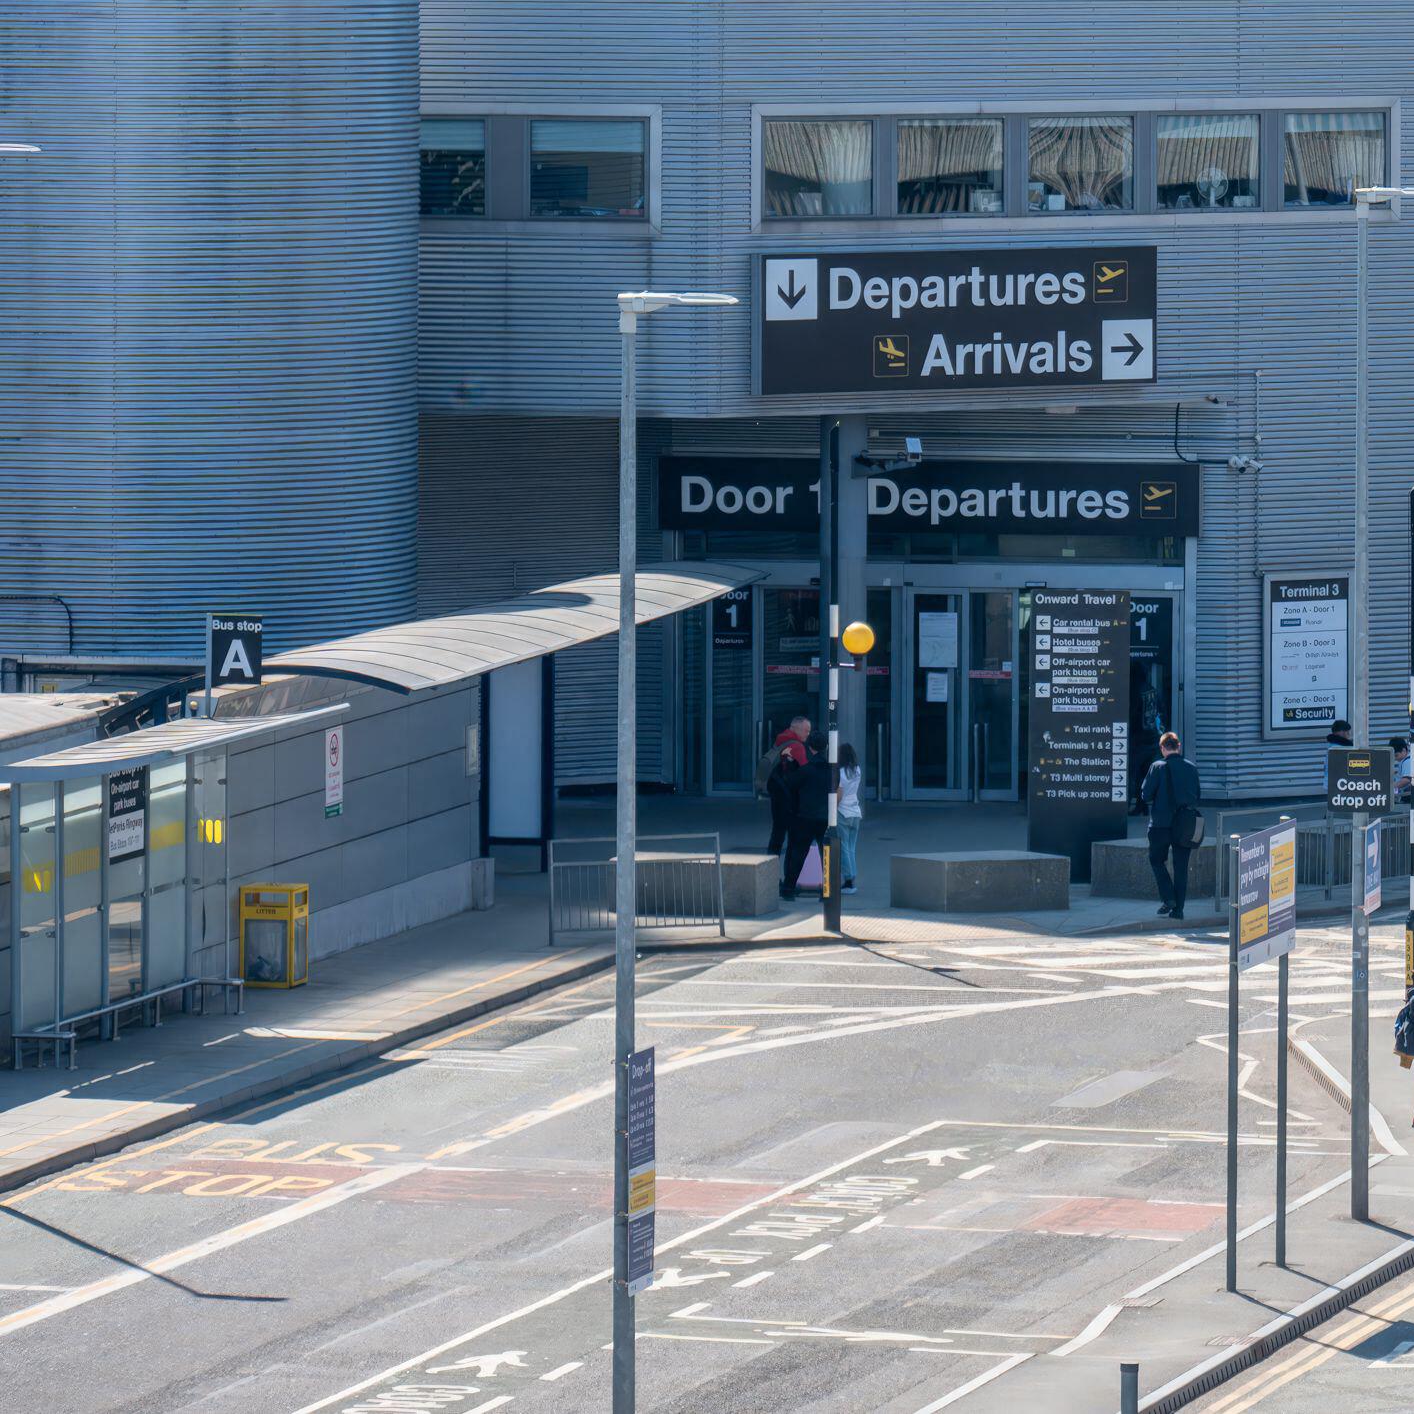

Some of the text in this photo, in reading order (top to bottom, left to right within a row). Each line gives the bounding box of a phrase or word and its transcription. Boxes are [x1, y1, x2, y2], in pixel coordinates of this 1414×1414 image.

[828, 266, 1086, 318] Departures
[920, 330, 1093, 377] Arrivals
[680, 475, 793, 514] Door
[867, 478, 1130, 525] Departures
[1280, 584, 1340, 598] Terminal 3
[1035, 594, 1116, 605] Onward Travel
[725, 604, 737, 628] 1
[1301, 606, 1308, 614] A
[212, 620, 262, 633] Bus stop
[1053, 618, 1111, 626] Car rental bus
[1135, 617, 1147, 641] 1
[219, 639, 254, 678] A
[1052, 658, 1096, 667] Off-airport
[1052, 686, 1095, 695] On-airport
[1283, 696, 1301, 704] Zone
[1295, 708, 1334, 719] Security
[1048, 741, 1089, 750] Terminals
[1081, 758, 1110, 766] Station
[1050, 773, 1110, 783] T3 Multi storey
[1336, 778, 1381, 791] Coach
[1046, 789, 1056, 797] T3
[1058, 789, 1076, 798] Pick
[1078, 791, 1089, 799] up
[1332, 794, 1387, 809] drop off
[185, 1139, 401, 1163] BUS
[55, 1169, 335, 1197] STOP
